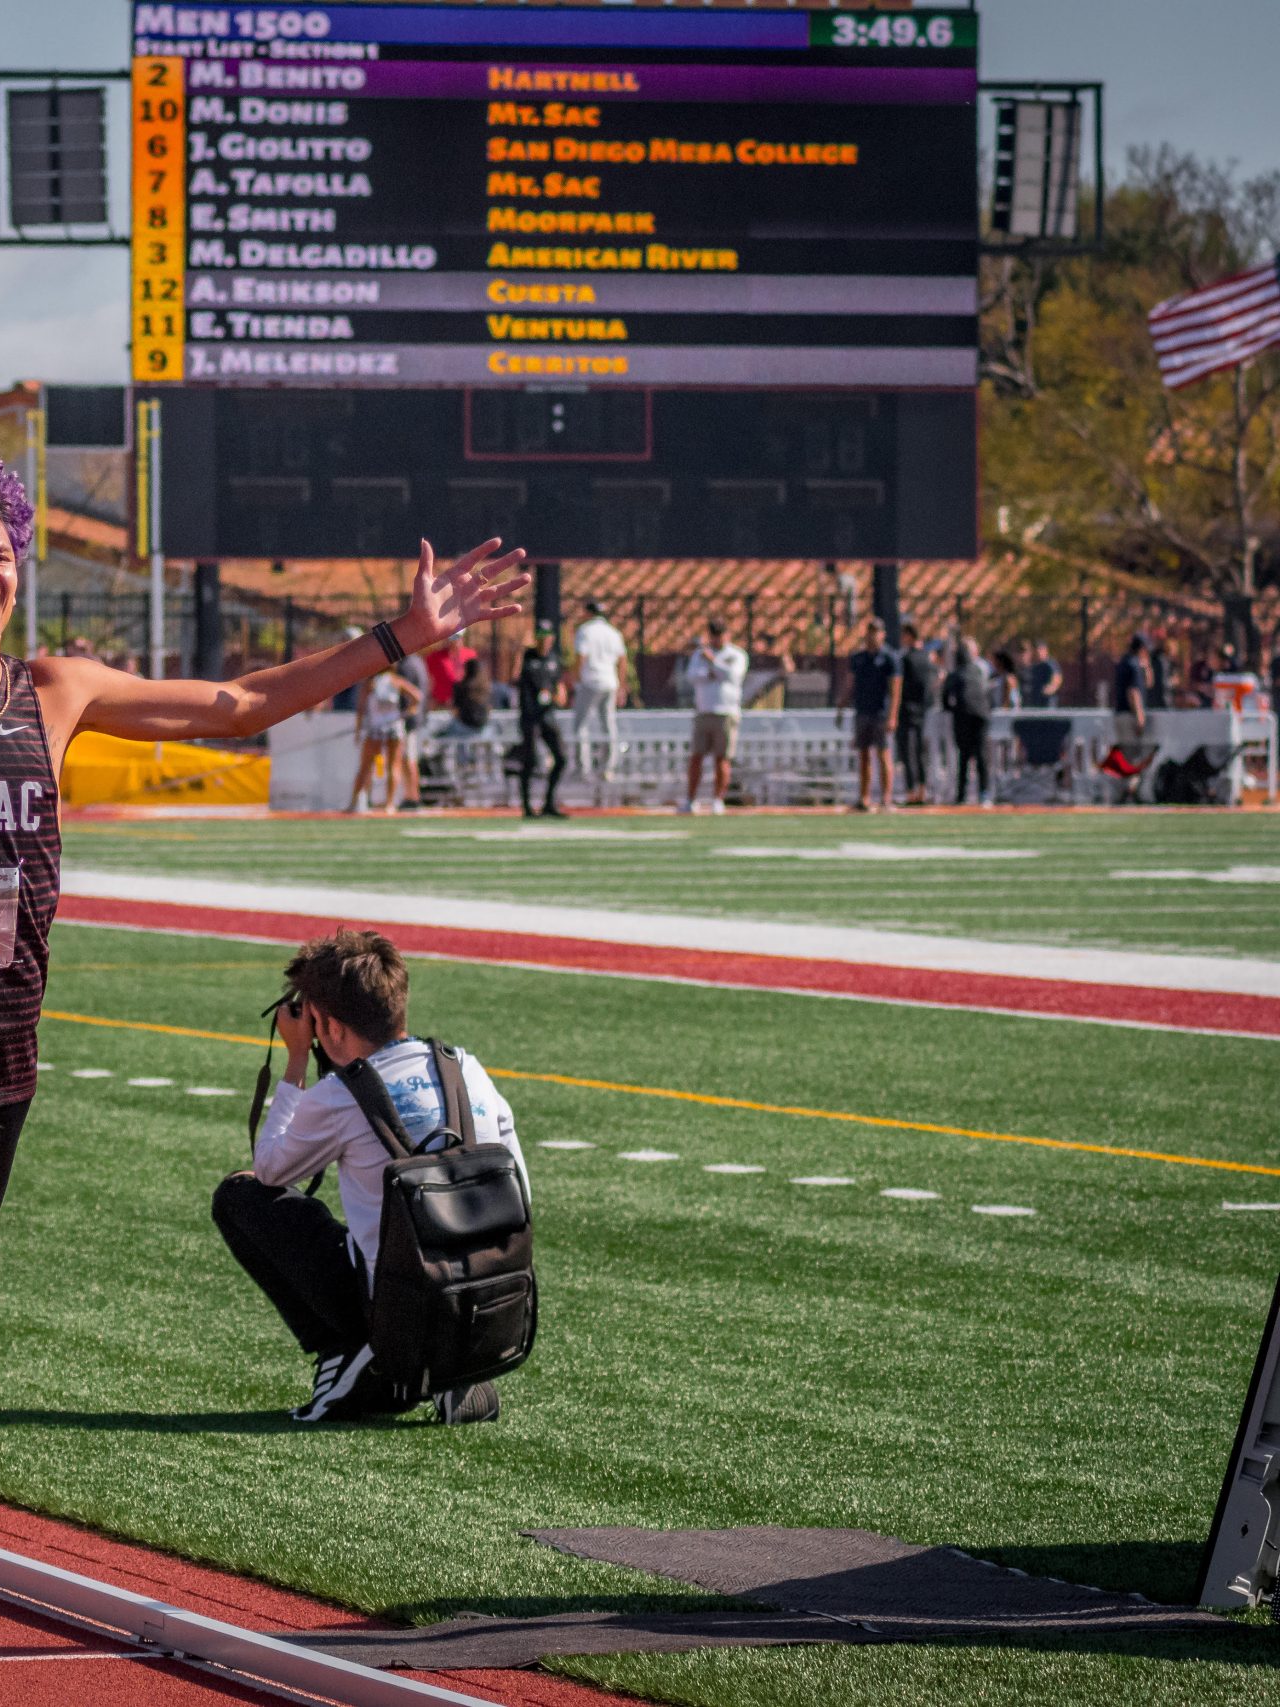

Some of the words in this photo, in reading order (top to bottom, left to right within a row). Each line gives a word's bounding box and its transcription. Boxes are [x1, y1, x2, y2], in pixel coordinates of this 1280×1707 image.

[235, 11, 330, 40] 1500
[834, 15, 951, 45] 3:49.6
[148, 63, 168, 86] 2
[141, 99, 179, 122] 10
[148, 135, 167, 158] 6
[148, 171, 166, 193] 7
[148, 208, 168, 229] 8
[148, 242, 167, 265] 3
[141, 279, 179, 301] 12
[142, 315, 174, 336] 11
[148, 350, 168, 371] 9
